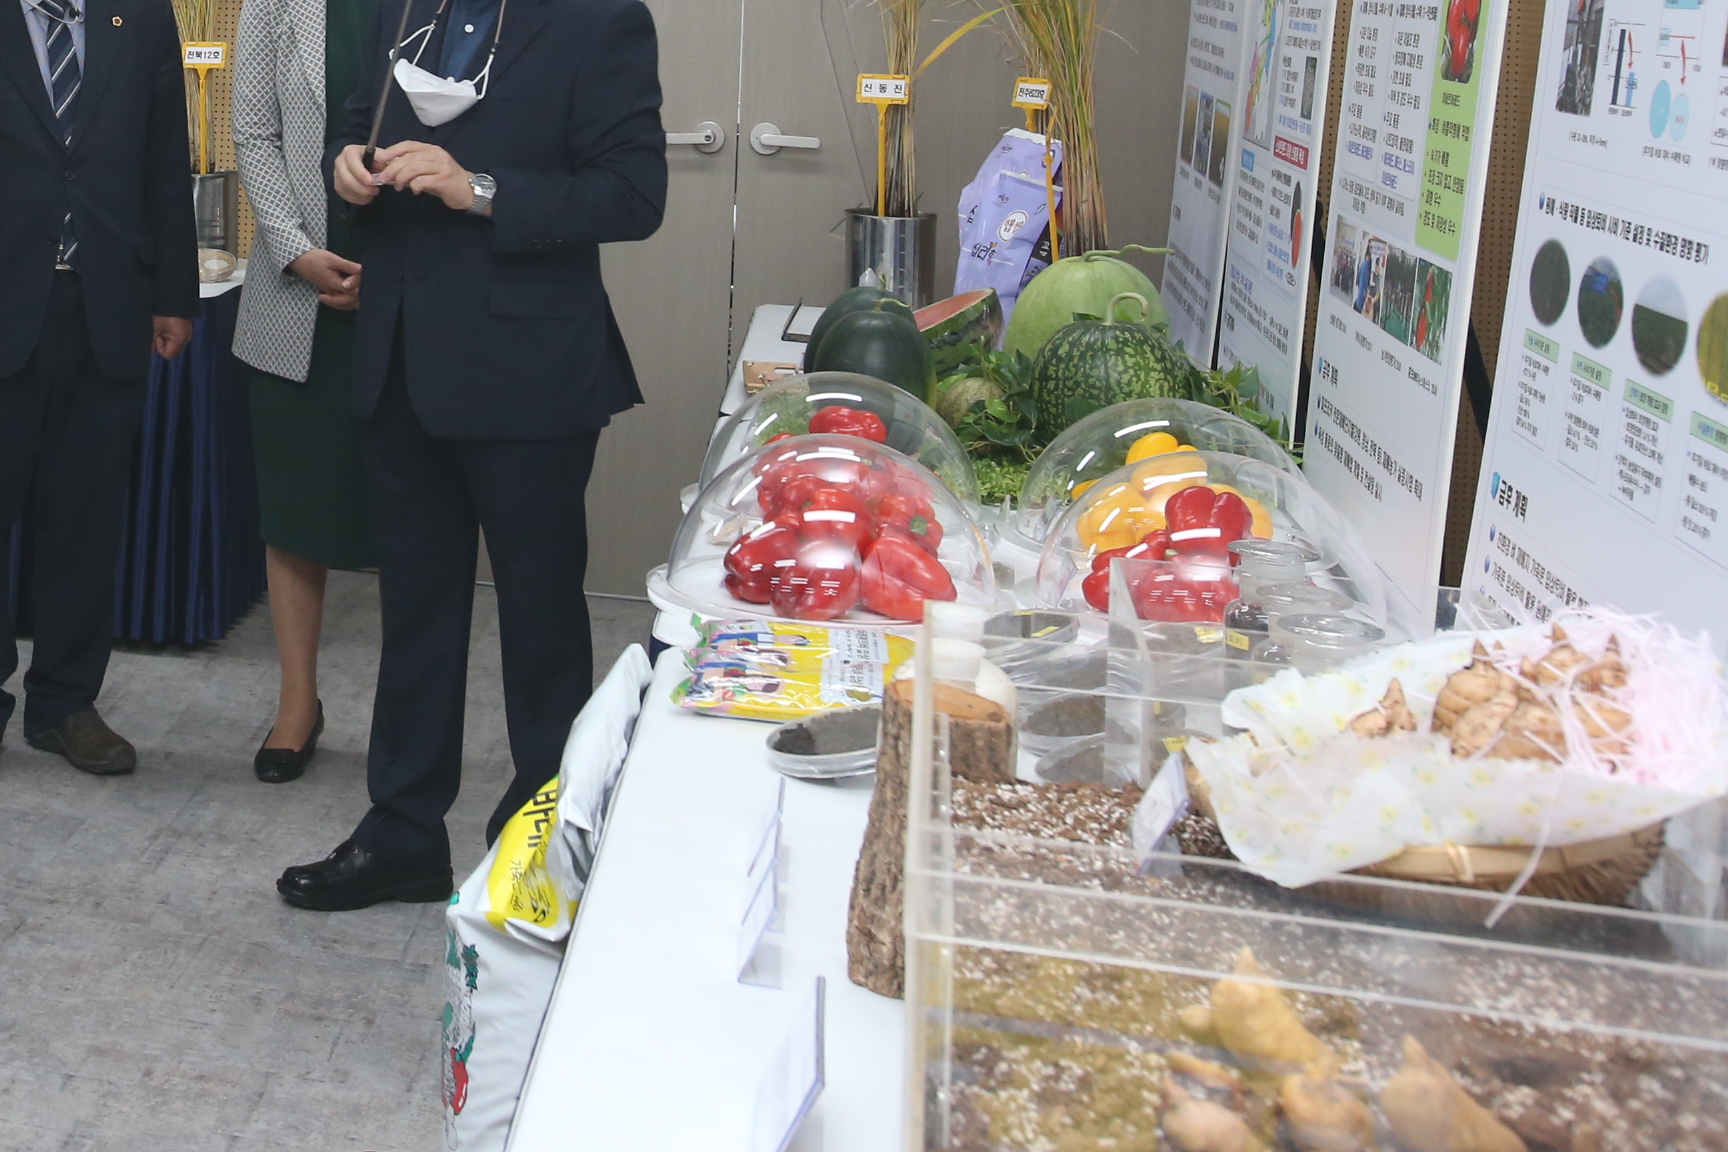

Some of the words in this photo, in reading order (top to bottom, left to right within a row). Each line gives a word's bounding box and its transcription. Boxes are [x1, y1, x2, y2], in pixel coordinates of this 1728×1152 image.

[187, 50, 220, 60] 전북12호
[1570, 205, 1579, 223] 작물
[1580, 208, 1586, 225] 등
[1586, 210, 1607, 232] 입상퇴비
[1608, 217, 1619, 236] 시비
[1620, 220, 1632, 240] 기준
[1633, 224, 1645, 244] 설정
[1645, 228, 1652, 247] 및
[1654, 231, 1678, 254] 수질환경
[1680, 238, 1694, 259] 영향
[1695, 242, 1709, 263] 평가
[1323, 360, 1330, 379] 금후
[1330, 366, 1338, 387] 계획
[1499, 480, 1513, 509] 금후
[1513, 490, 1528, 522] 계획
[1492, 562, 1506, 587] 가축분
[1497, 532, 1511, 556] 친환경
[1516, 547, 1530, 572] 재배지
[1530, 559, 1545, 585] 가축분
